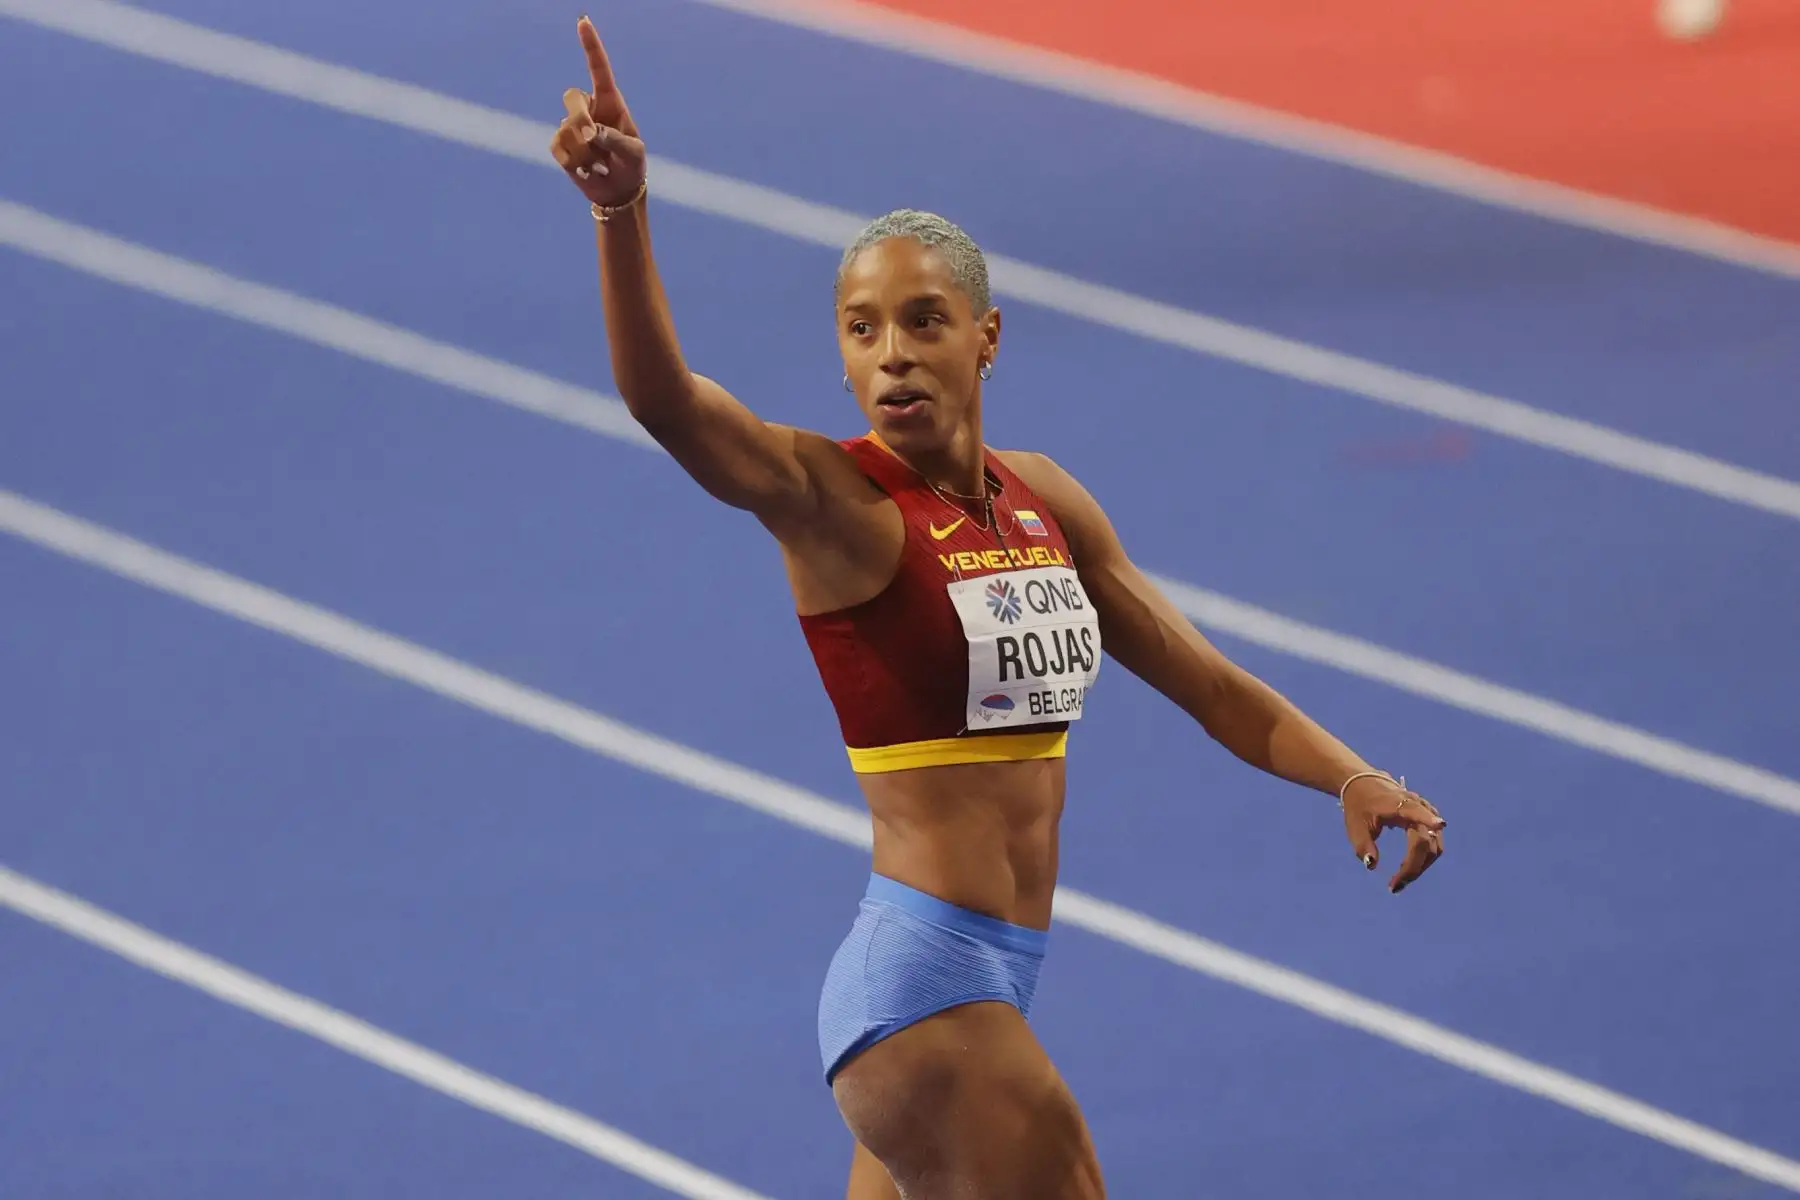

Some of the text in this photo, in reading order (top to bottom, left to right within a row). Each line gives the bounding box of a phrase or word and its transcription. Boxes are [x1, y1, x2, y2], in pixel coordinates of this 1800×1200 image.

[938, 547, 1067, 572] VENEZUELA
[1025, 577, 1084, 614] QNB
[996, 627, 1094, 682] ROJAS
[1028, 686, 1087, 716] BELGRA
